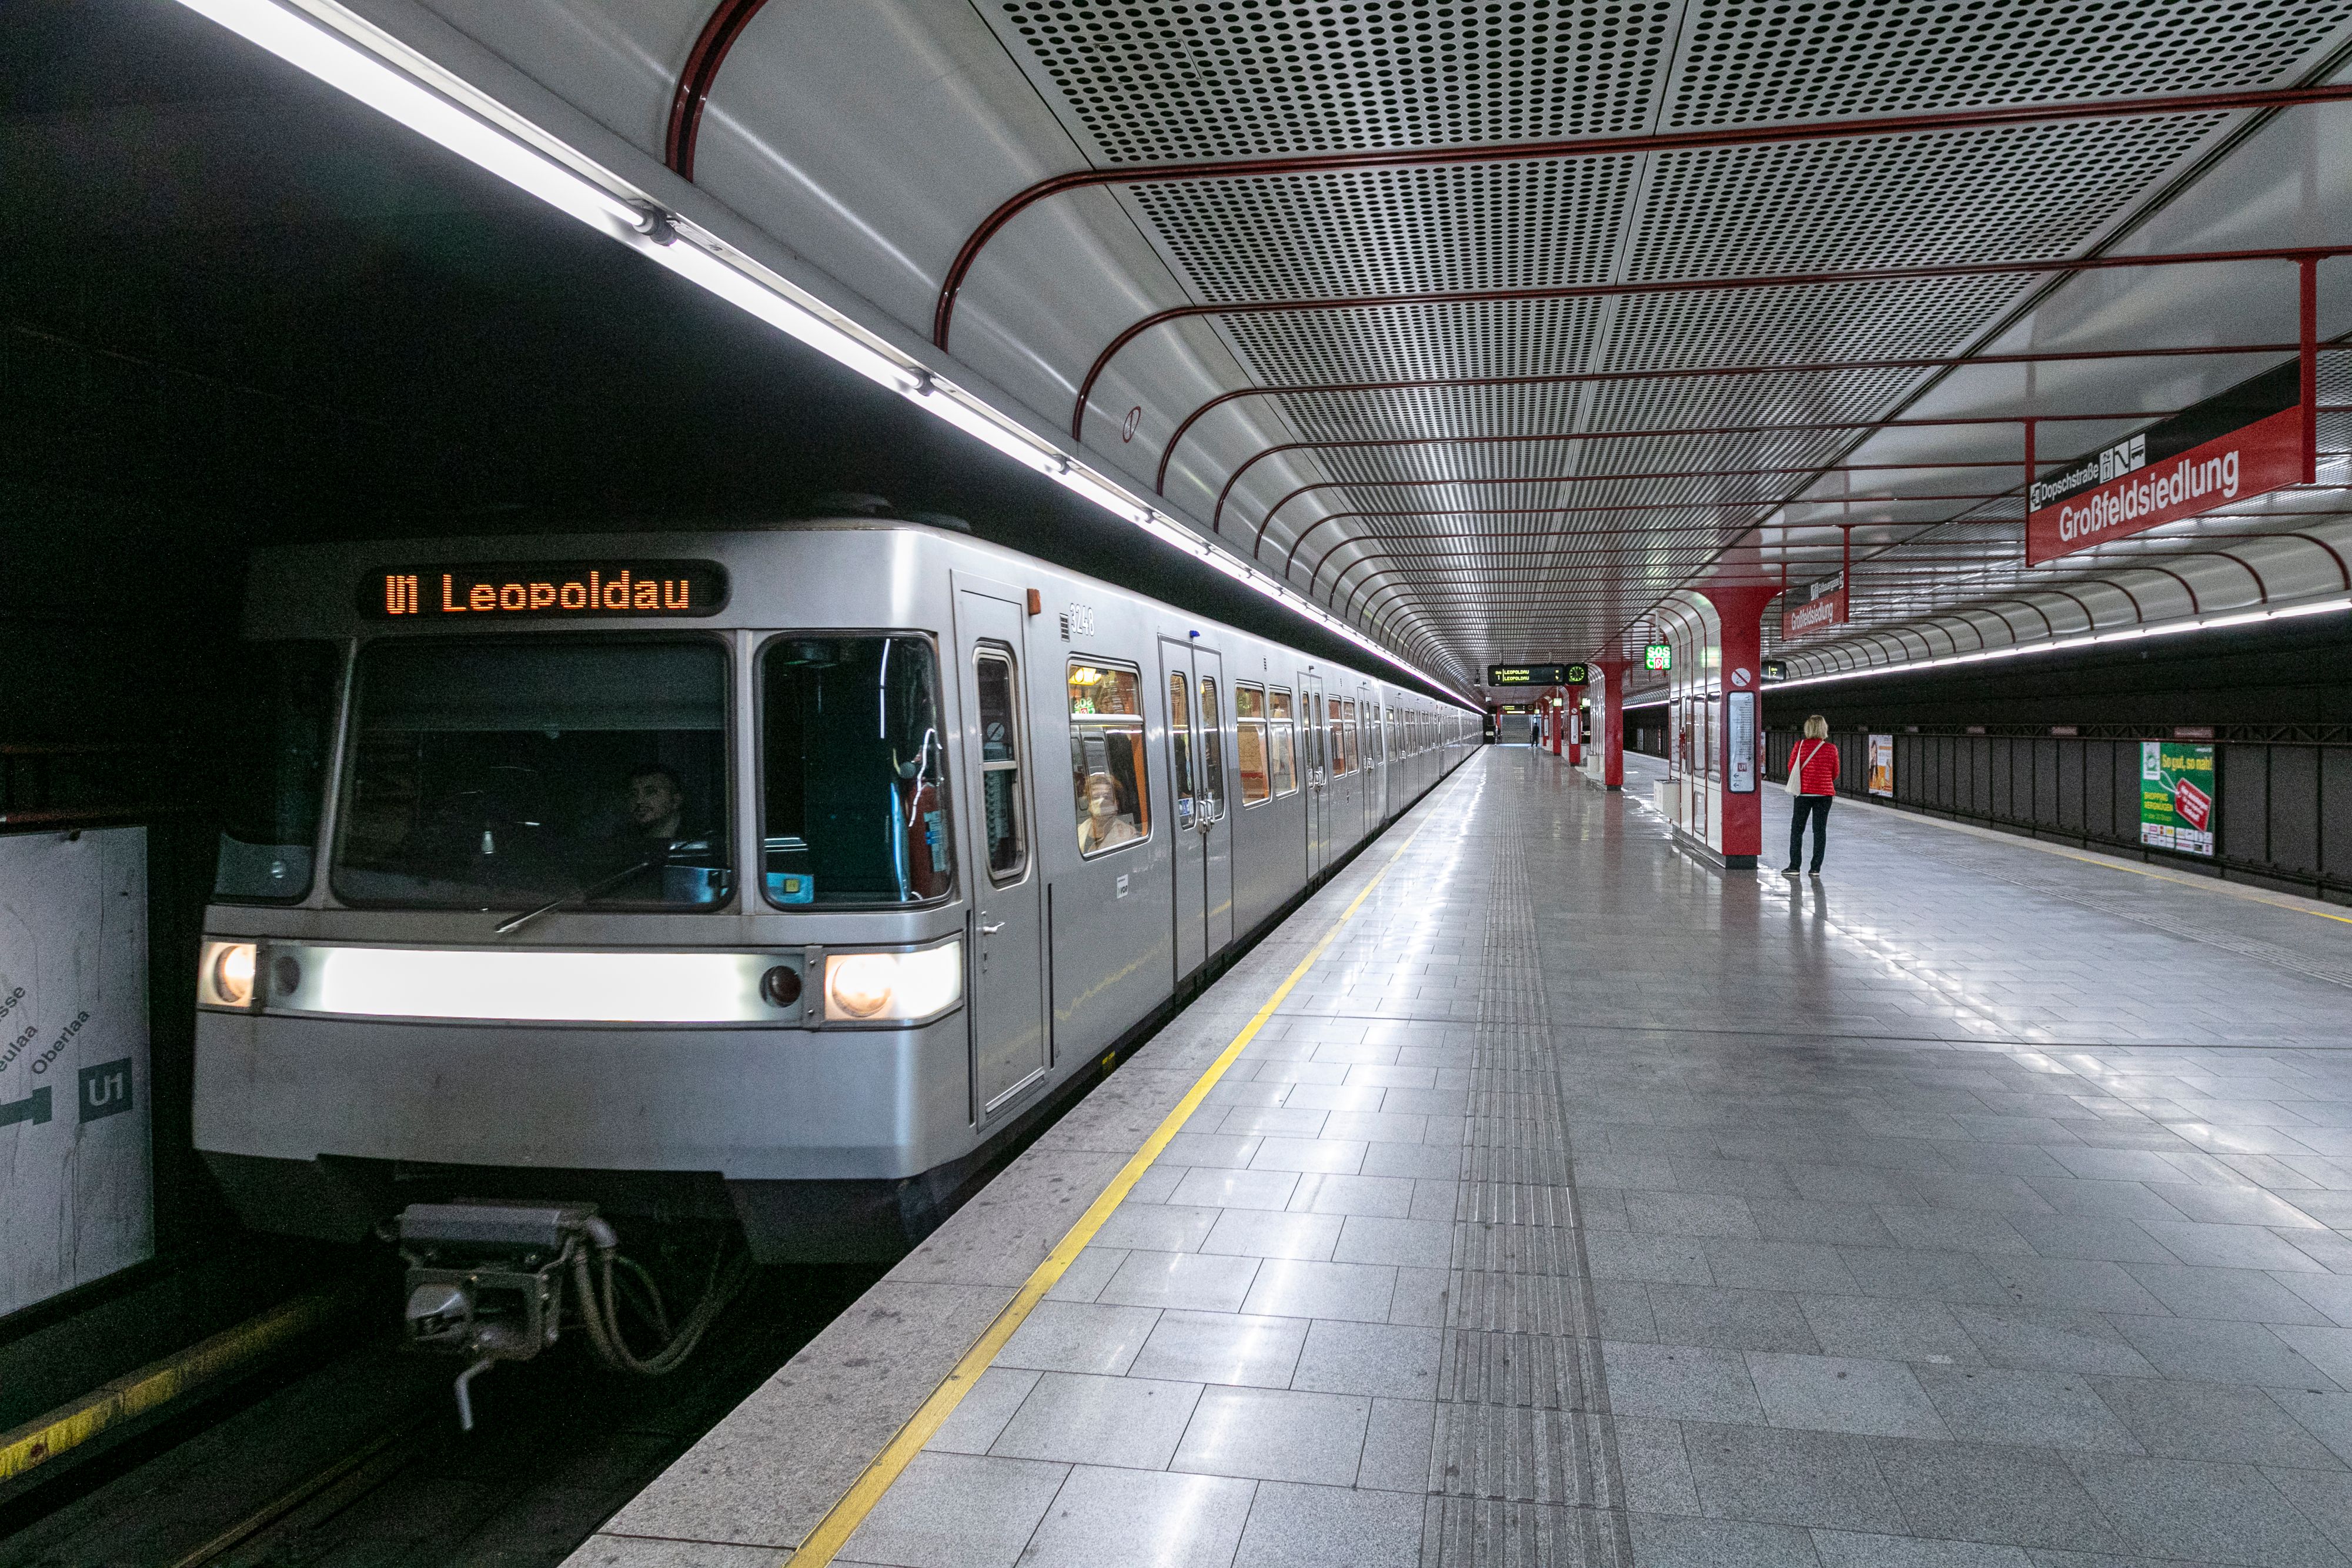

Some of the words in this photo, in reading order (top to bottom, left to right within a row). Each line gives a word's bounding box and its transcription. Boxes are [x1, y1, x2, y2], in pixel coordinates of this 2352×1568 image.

[2042, 462, 2099, 501] Dopschstraße
[2059, 450, 2239, 542] Großfeldsiedlung
[443, 570, 689, 612] Leopoldau
[1070, 603, 1095, 636] 3248
[1791, 601, 1833, 631] Großfeldsiedlung
[1647, 646, 1671, 657] SOS
[32, 1011, 90, 1075] Oberlaa
[89, 1072, 123, 1106] U1
